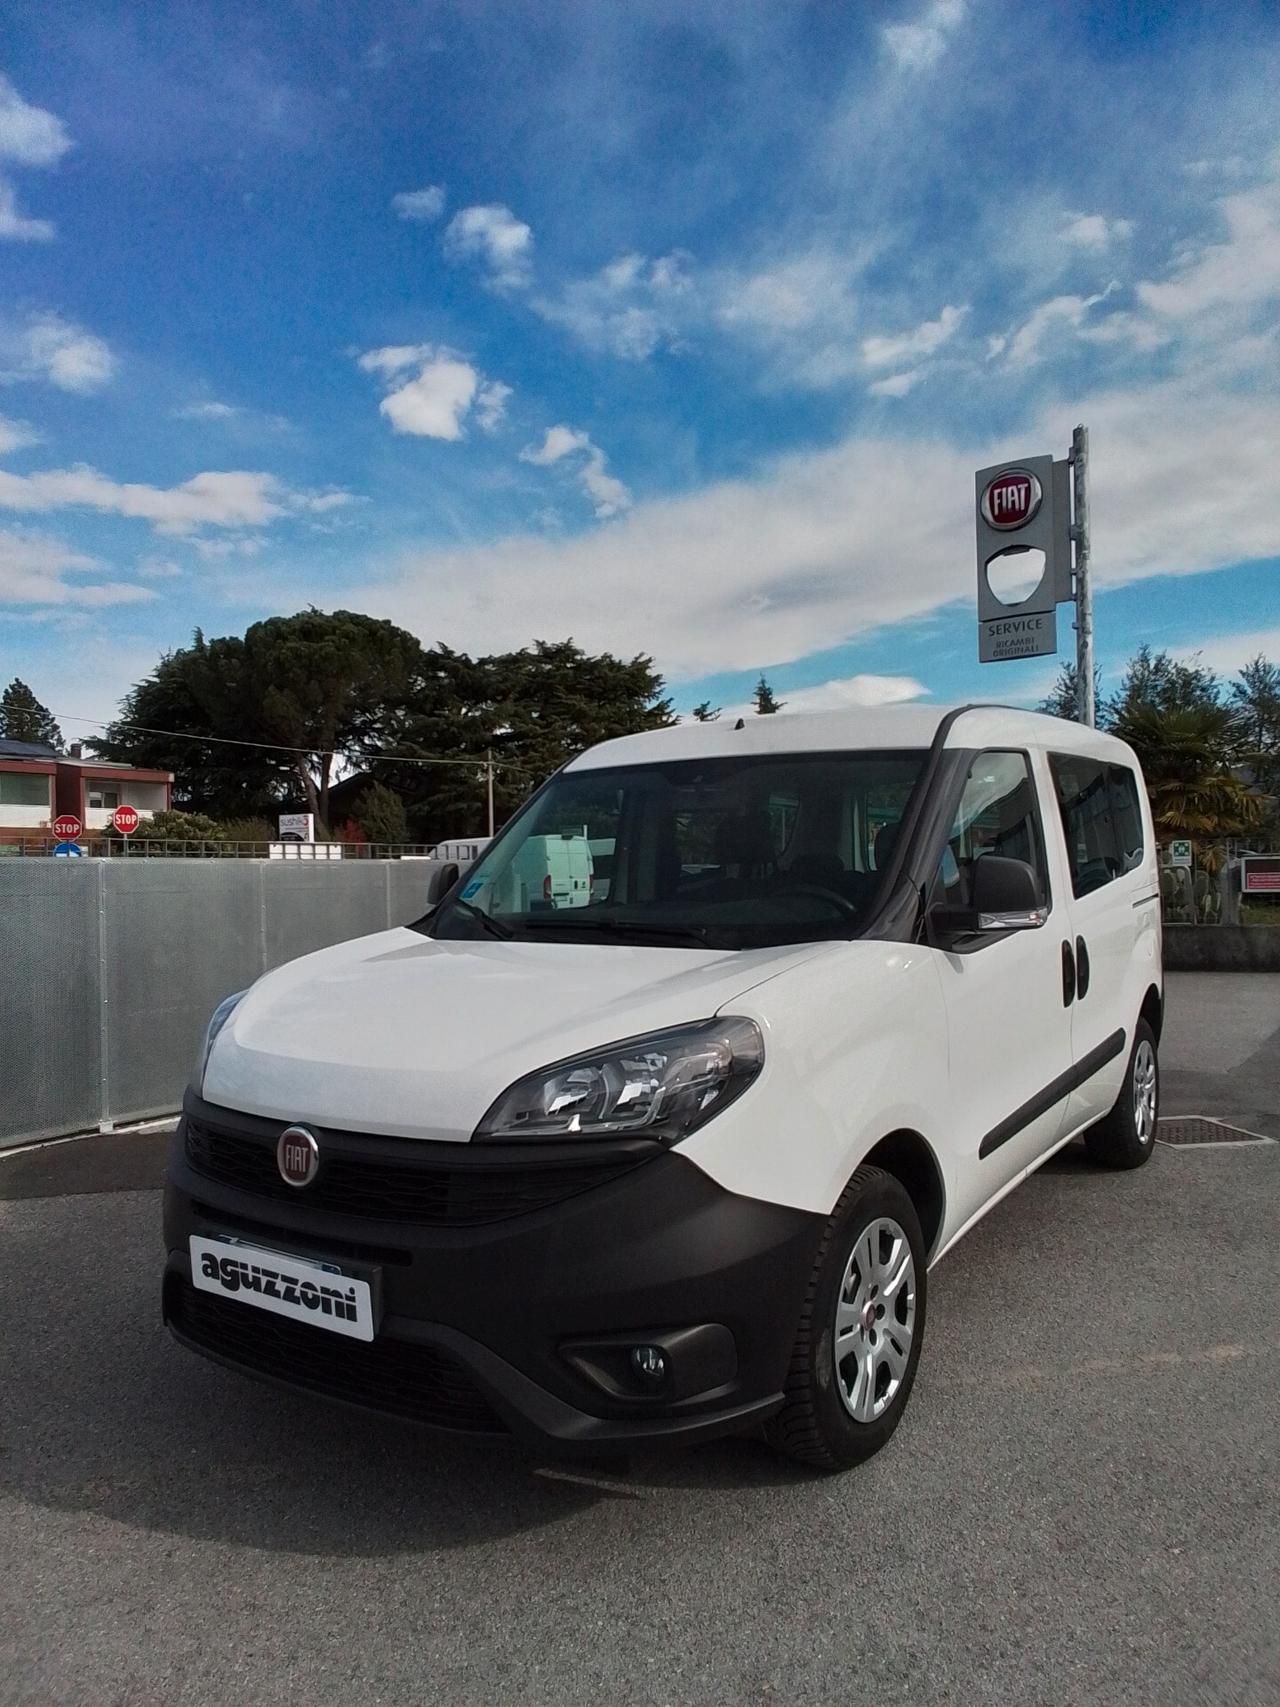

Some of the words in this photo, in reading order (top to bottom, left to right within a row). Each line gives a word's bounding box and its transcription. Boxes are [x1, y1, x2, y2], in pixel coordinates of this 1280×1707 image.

[993, 483, 1028, 517] FIAT
[988, 618, 1042, 637] SERVICE
[993, 644, 1039, 658] ORIGINALI
[996, 637, 1035, 649] RICAMBI
[115, 814, 137, 825] STOP
[55, 823, 80, 834] STOP
[286, 1143, 309, 1173] FIAT
[200, 1252, 358, 1323] aguzzoni
